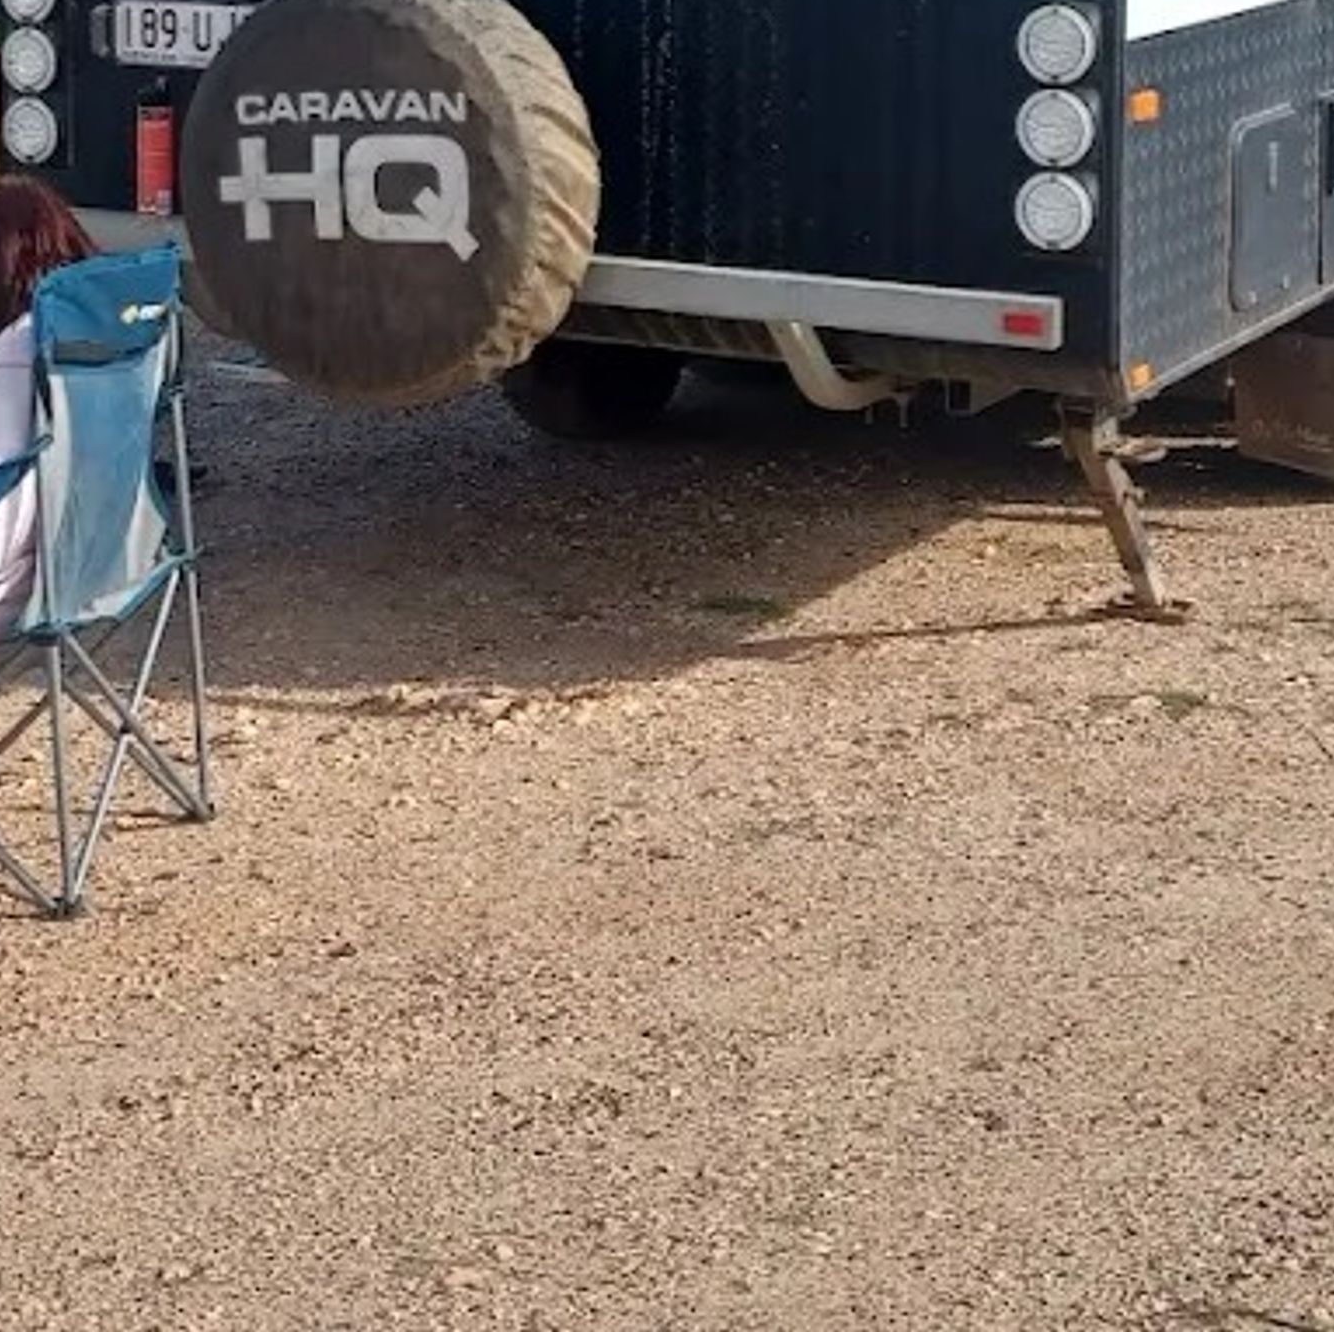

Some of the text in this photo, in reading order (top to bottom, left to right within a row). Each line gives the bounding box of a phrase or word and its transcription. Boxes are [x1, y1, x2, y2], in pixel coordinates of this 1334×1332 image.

[126, 7, 177, 49] 189
[236, 89, 466, 125] CARAVAN
[220, 134, 479, 261] HQ
